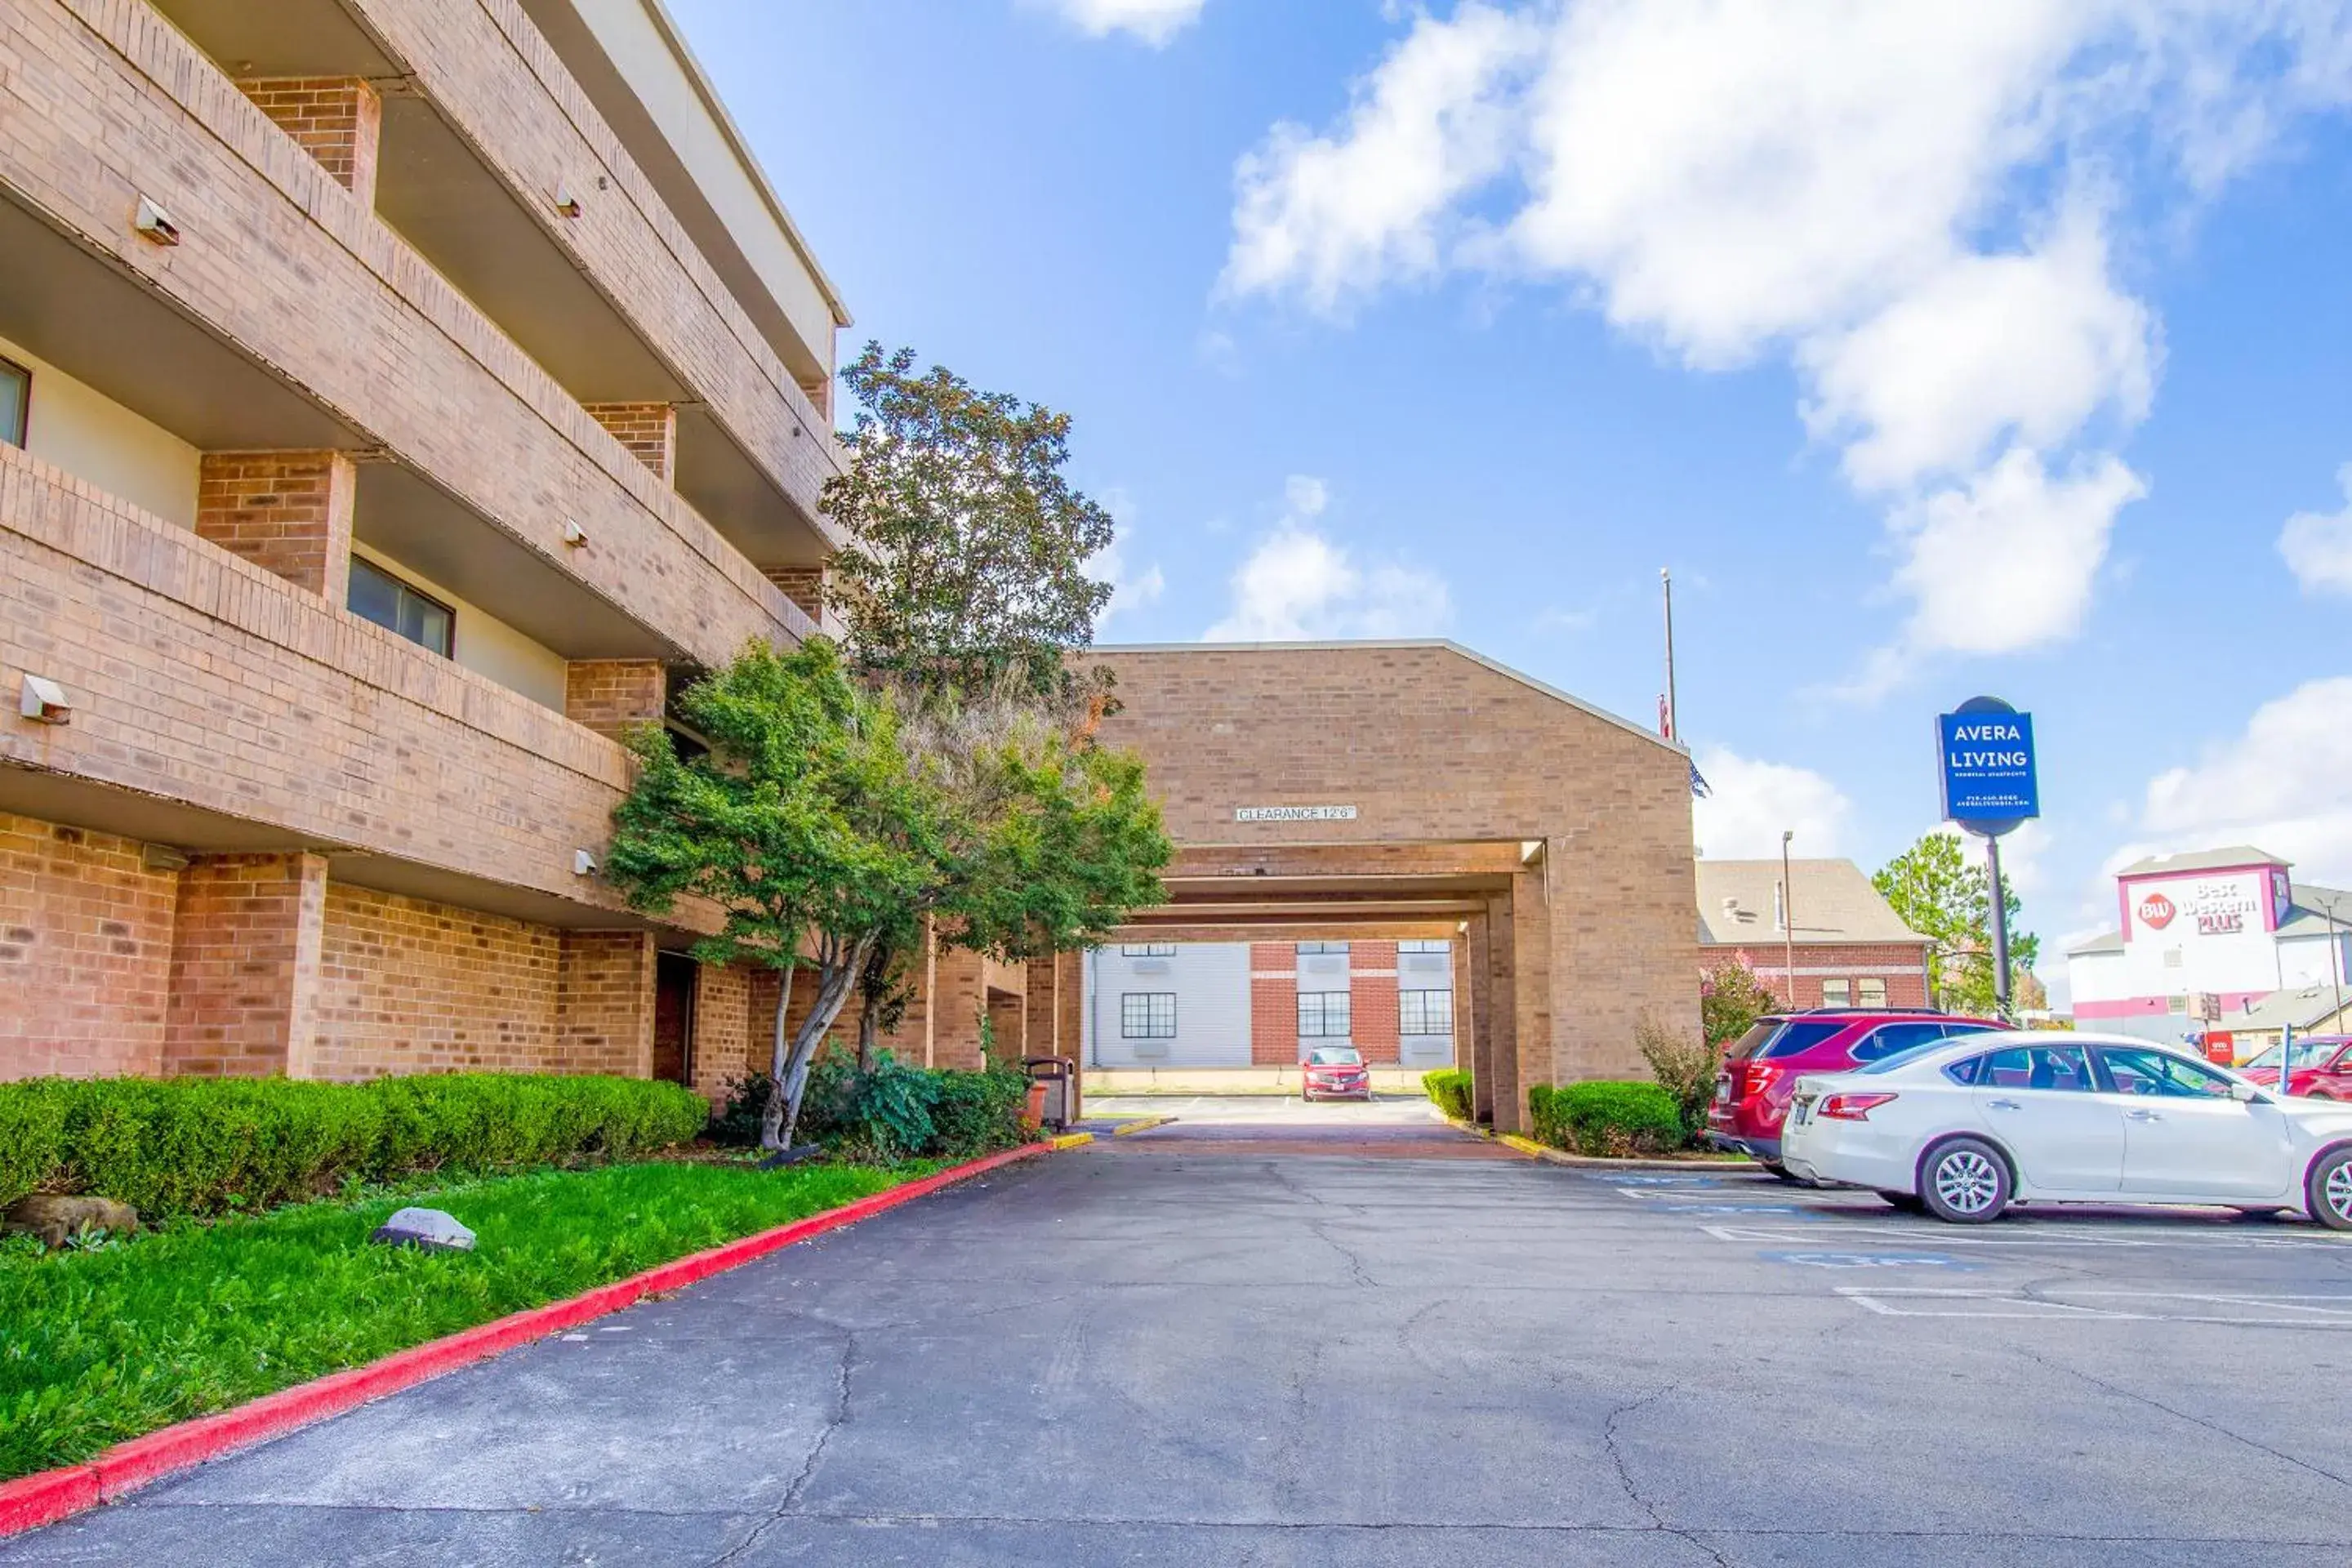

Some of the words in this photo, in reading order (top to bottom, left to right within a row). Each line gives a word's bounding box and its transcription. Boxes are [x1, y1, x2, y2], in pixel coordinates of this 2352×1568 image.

[1954, 725, 2020, 741] AVERA
[1951, 751, 2027, 768] LIVING
[1239, 808, 1318, 819] CLEARANCE
[2140, 901, 2169, 919] BW
[2198, 914, 2243, 931] PLUS
